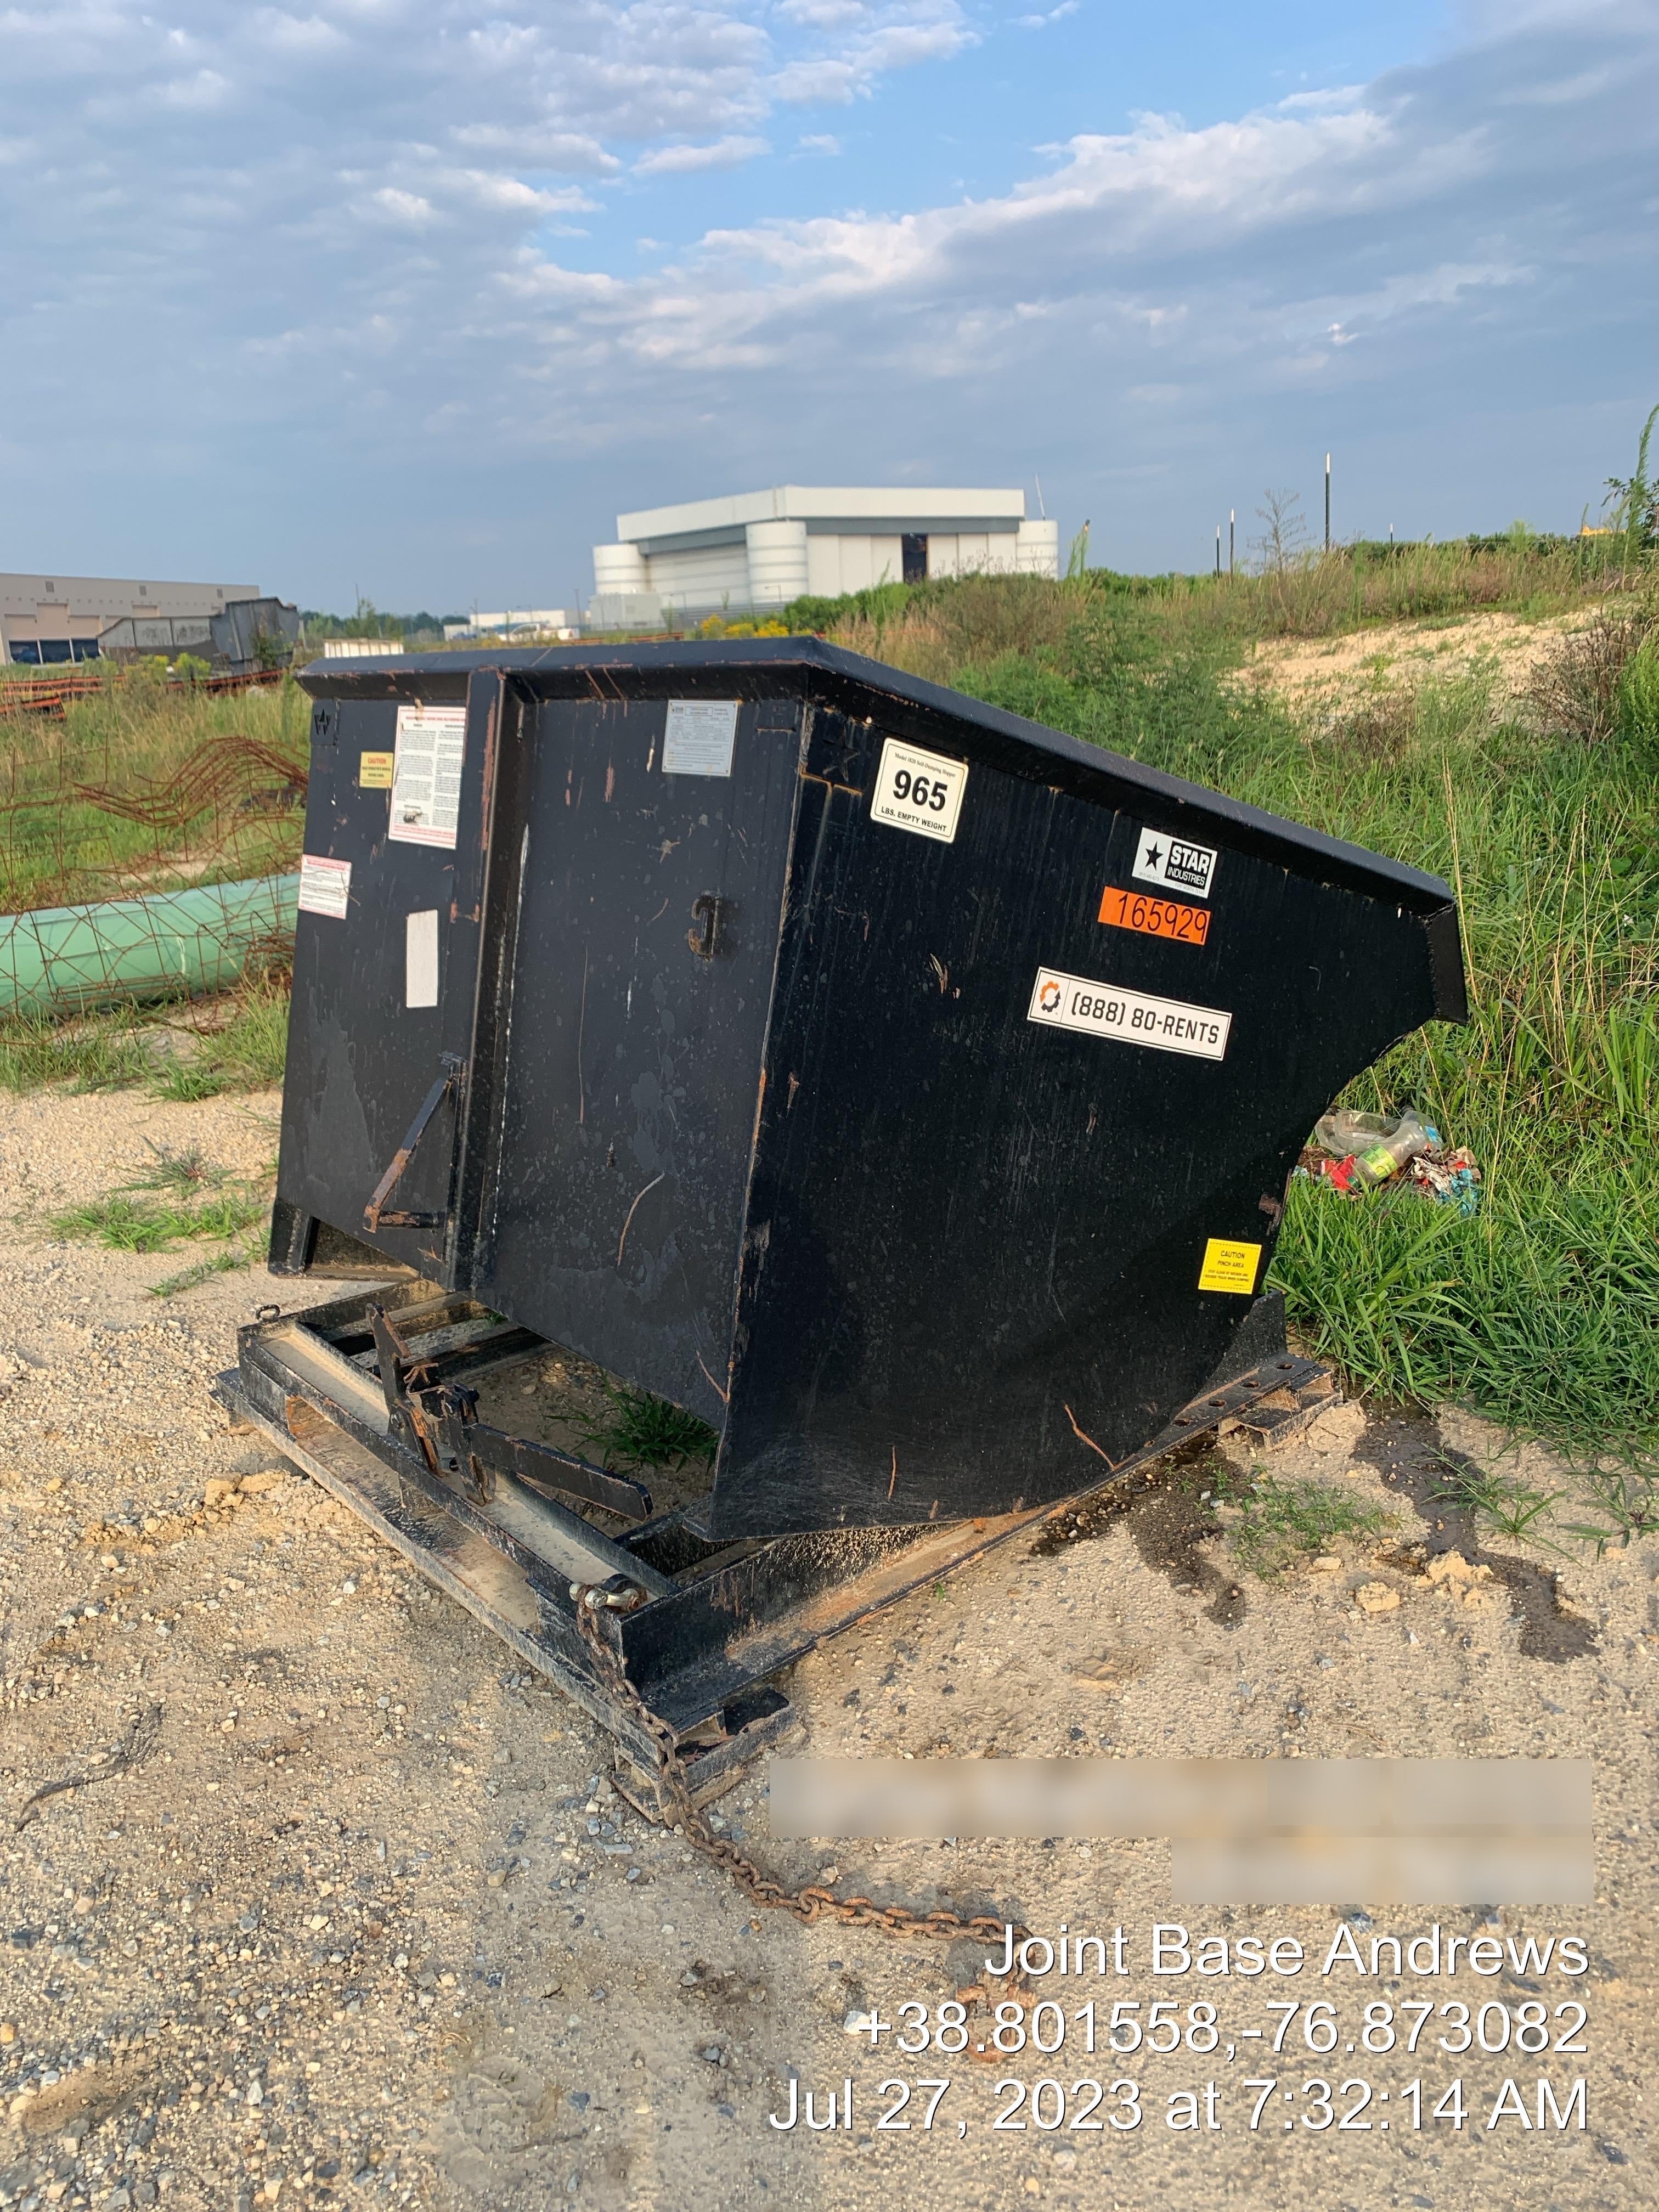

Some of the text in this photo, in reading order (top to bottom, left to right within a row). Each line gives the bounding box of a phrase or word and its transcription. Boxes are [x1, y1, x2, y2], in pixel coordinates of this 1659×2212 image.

[895, 752, 906, 762] Model
[943, 768, 956, 777] Hopper
[893, 769, 948, 811] 965
[881, 806, 947, 832] LBS. EMPTY WEIGHT
[1170, 845, 1210, 874] STAR
[1167, 866, 1206, 886] INDUSTRIES
[1118, 893, 1207, 942] 165929
[1071, 992, 1219, 1044] (888) 80-RENTS
[1221, 1250, 1245, 1259] CAUTION
